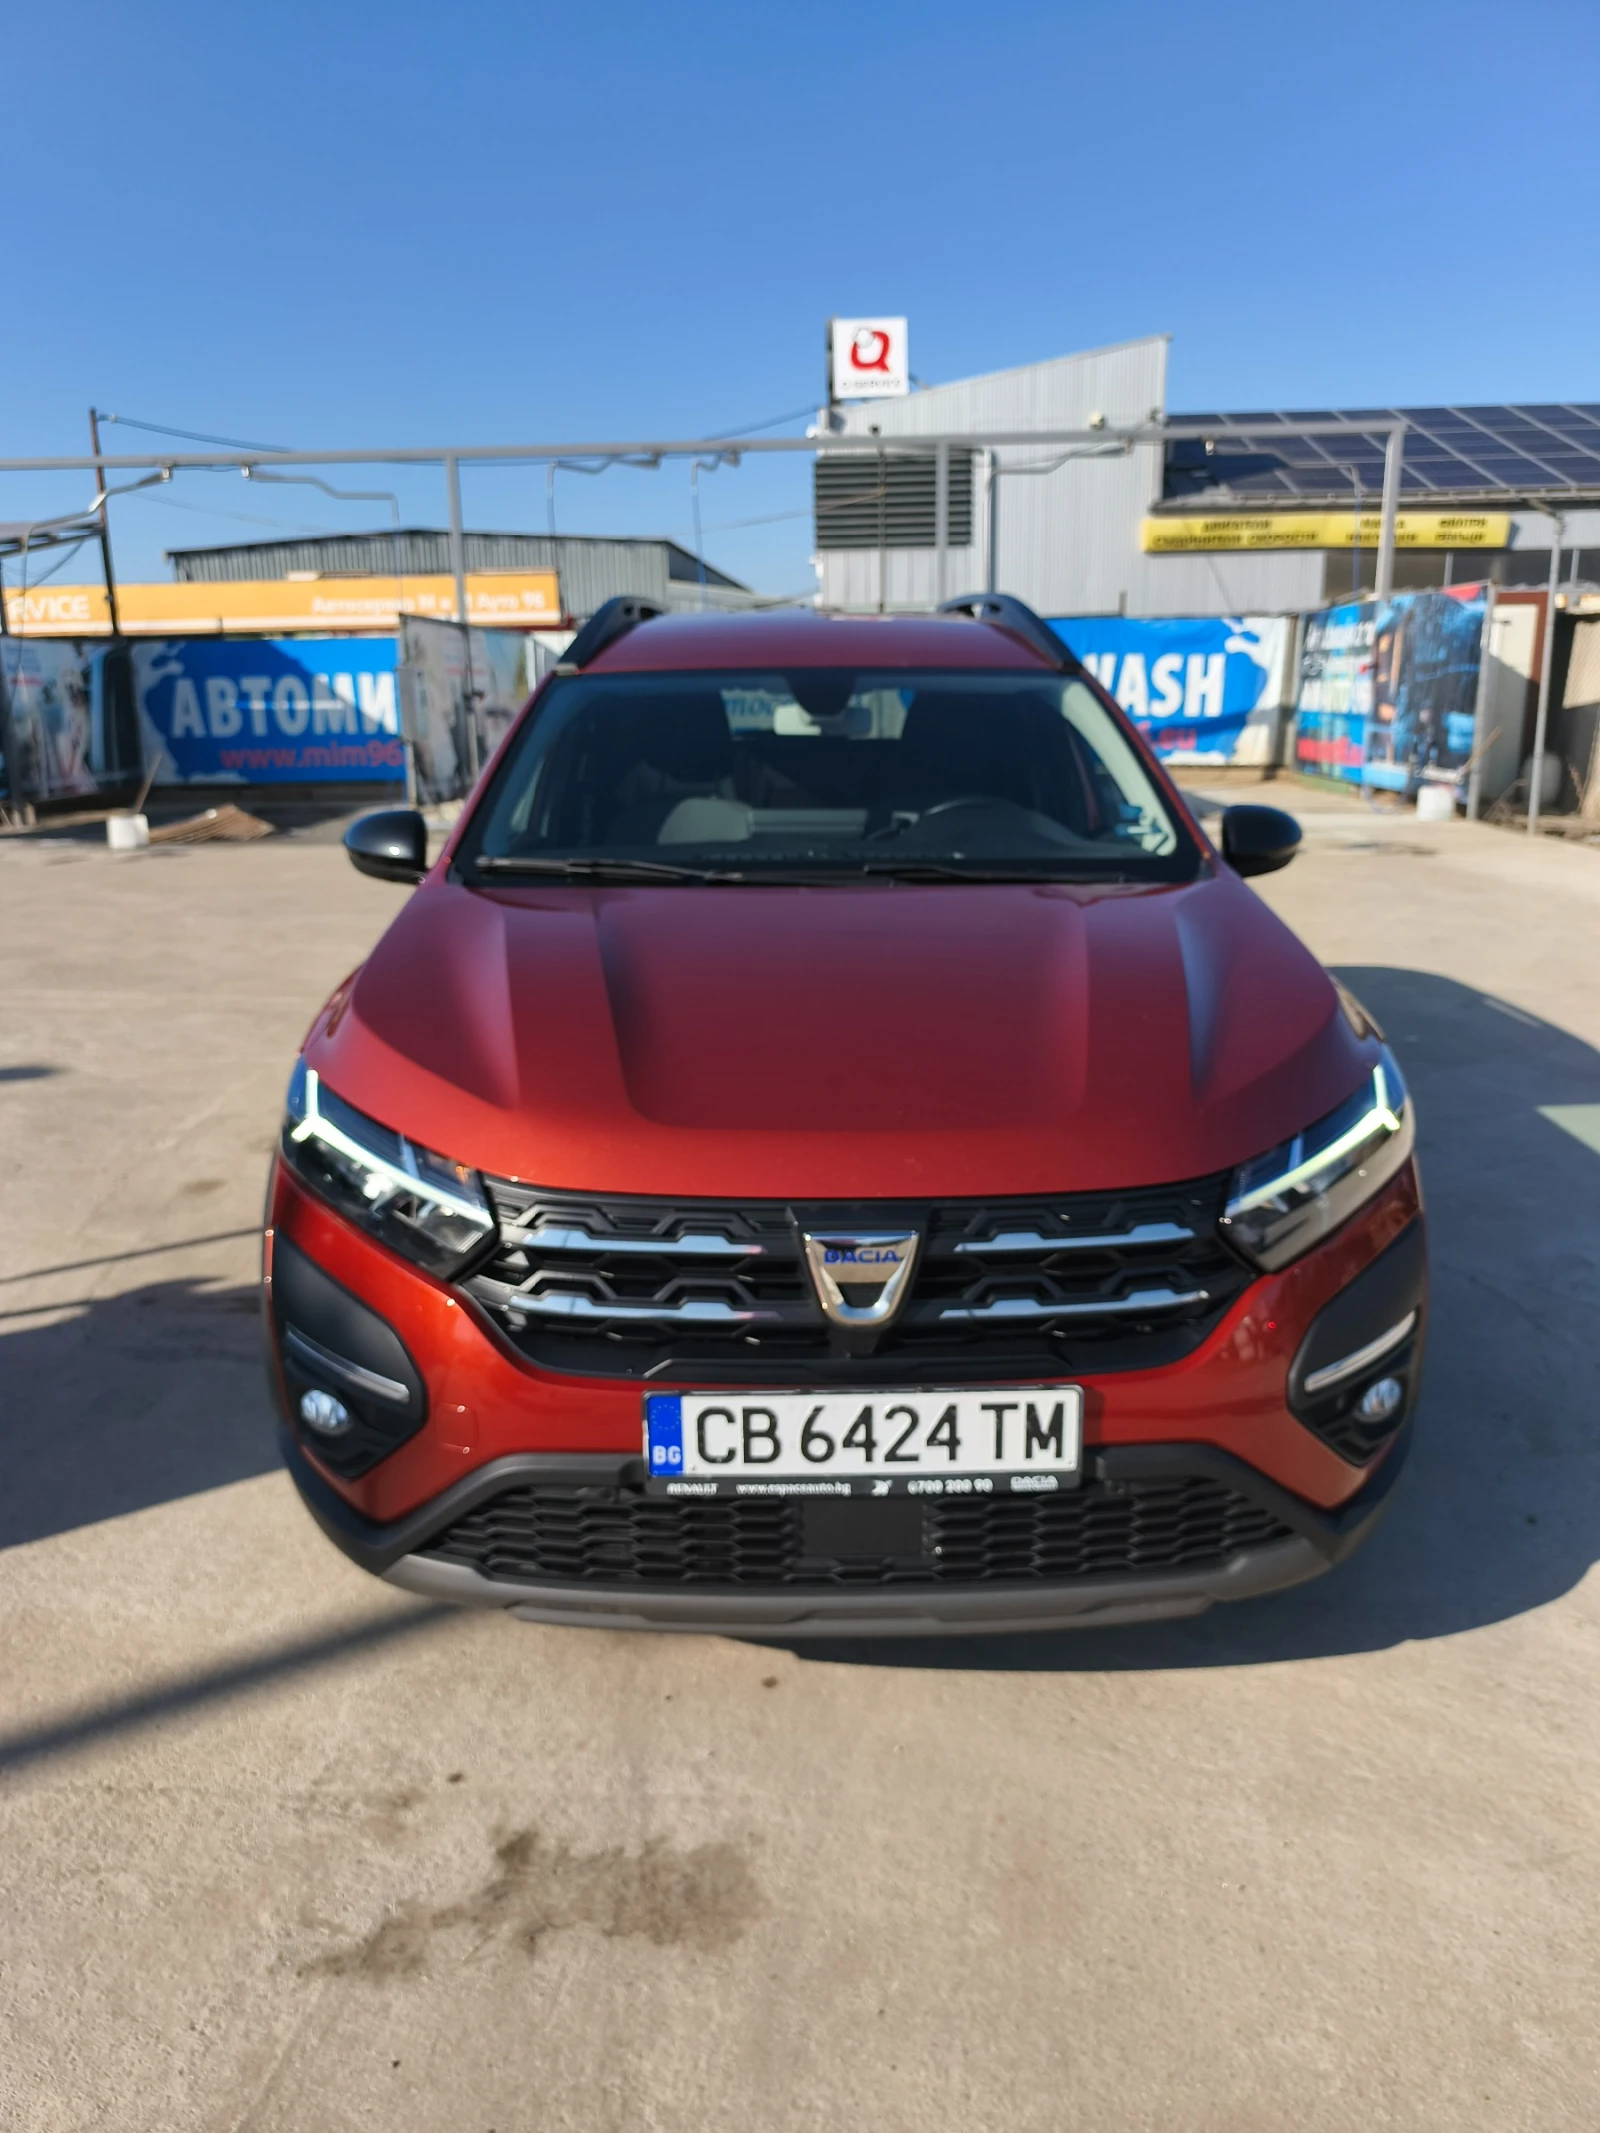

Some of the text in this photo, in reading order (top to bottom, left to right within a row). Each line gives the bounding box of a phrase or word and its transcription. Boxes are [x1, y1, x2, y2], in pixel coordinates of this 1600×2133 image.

[171, 671, 399, 738] АВТОМИ
[823, 1249, 900, 1265] DACIA
[695, 1402, 1065, 1465] CB 6424 TM
[652, 1446, 681, 1465] BG
